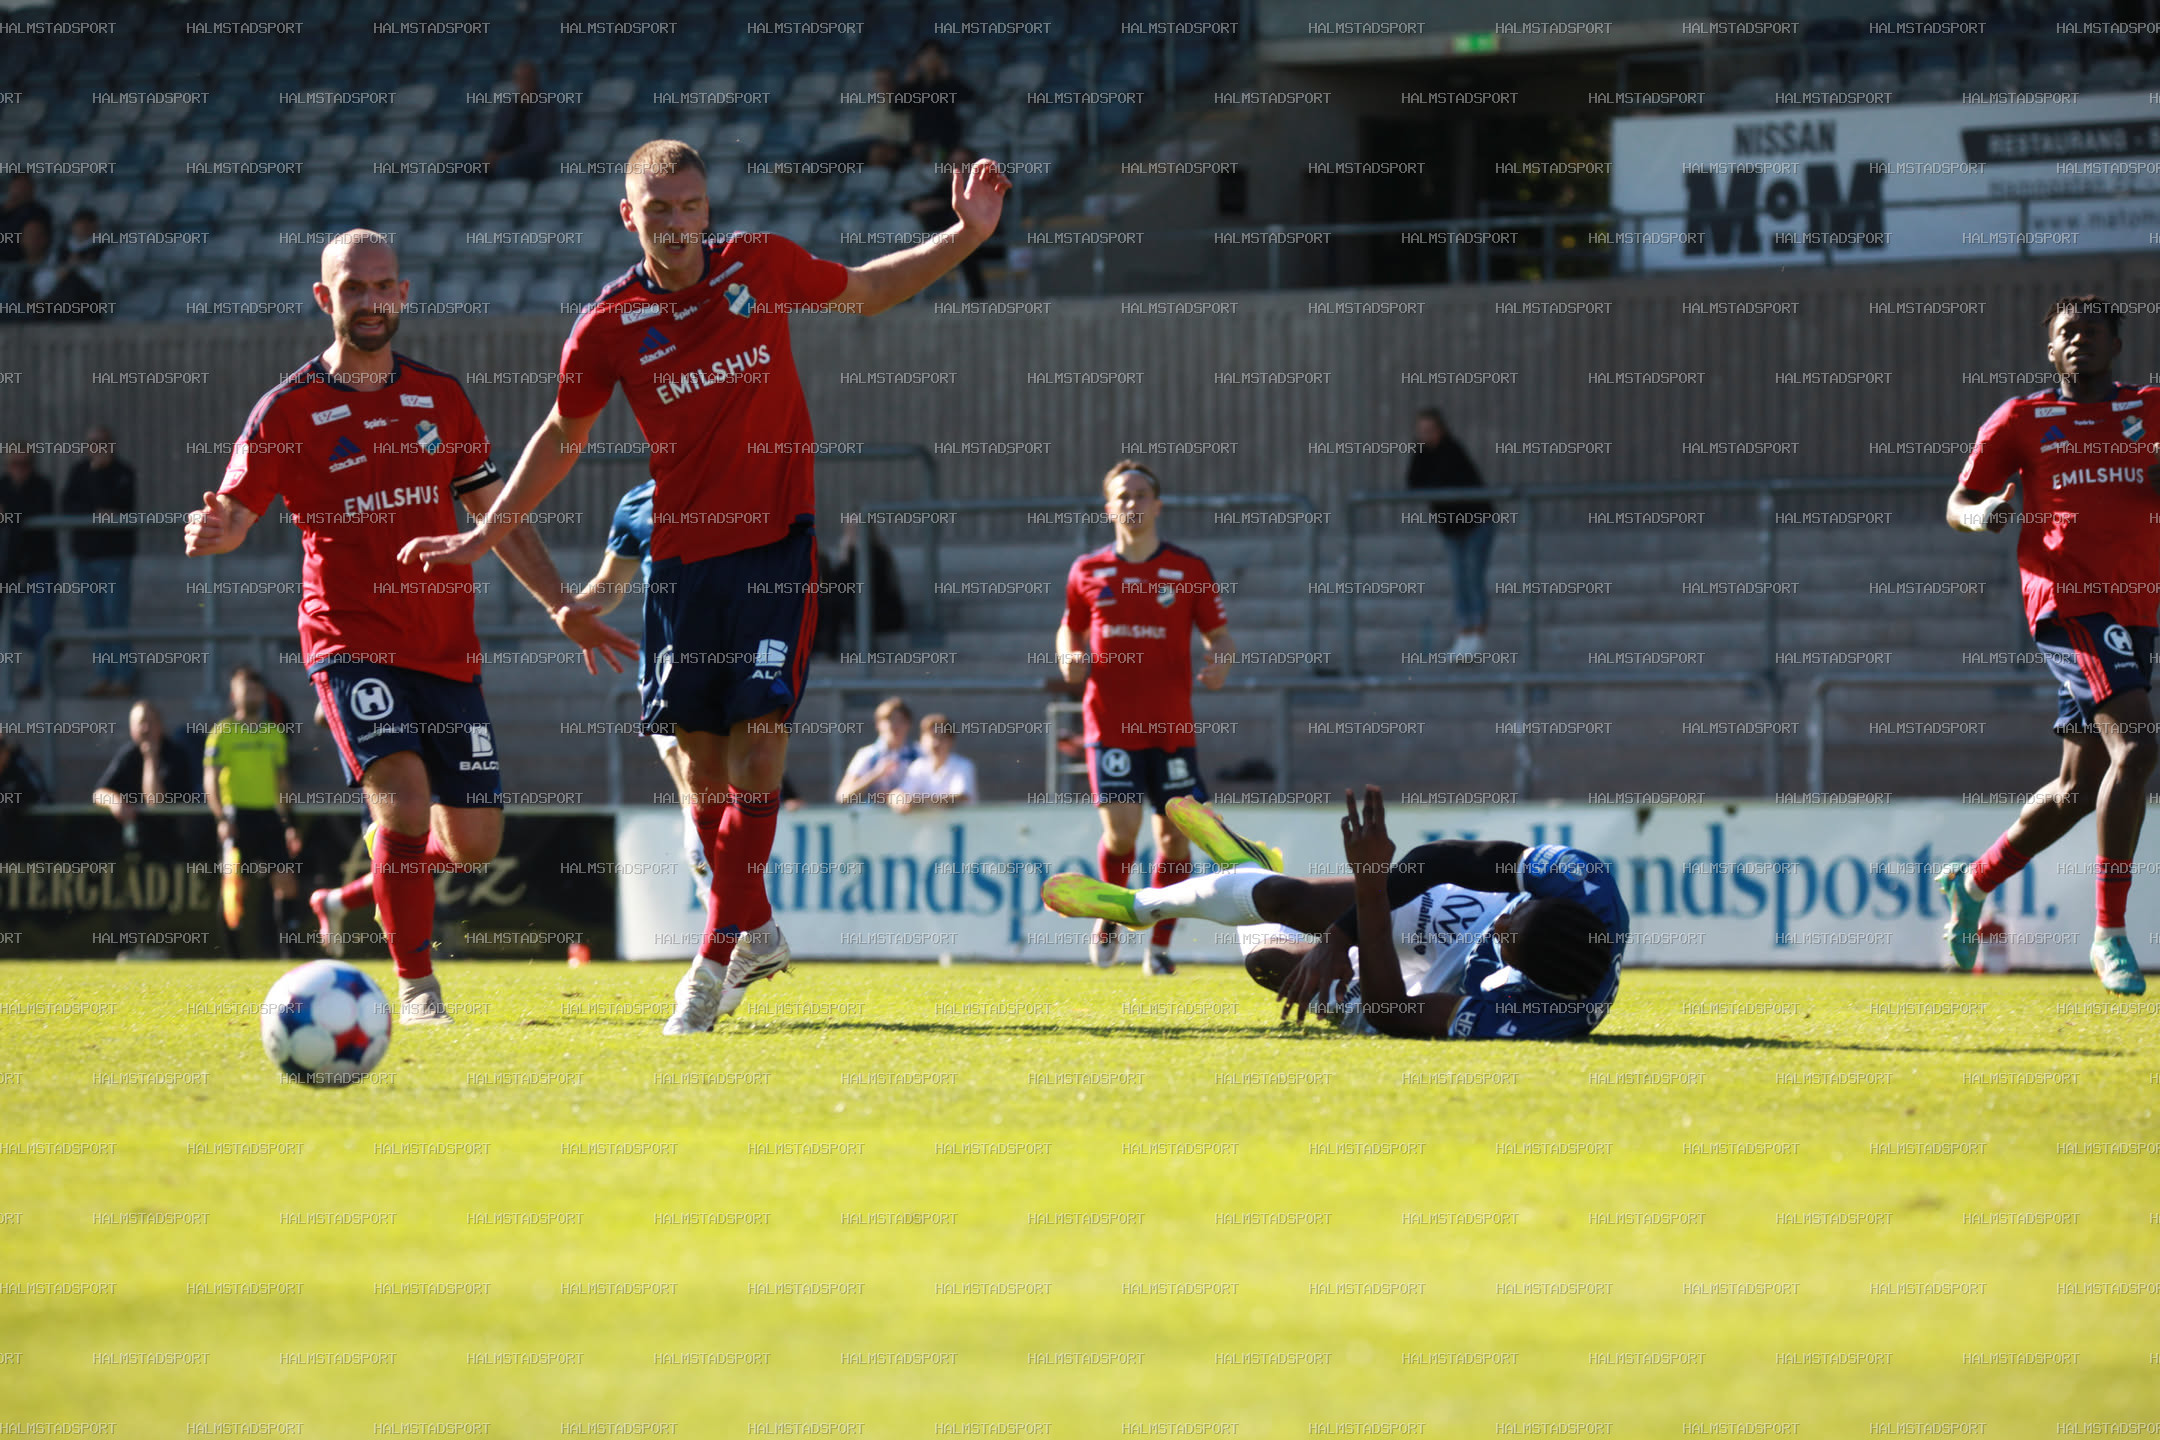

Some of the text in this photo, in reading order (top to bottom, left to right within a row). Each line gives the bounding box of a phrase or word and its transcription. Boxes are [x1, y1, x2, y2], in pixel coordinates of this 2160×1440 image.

[1735, 120, 1836, 156] NISSAN
[639, 344, 677, 366] stadium
[656, 344, 771, 405] EMILSHUS
[329, 454, 367, 473] stadium
[2052, 467, 2144, 490] EMILSHUS
[344, 485, 439, 517] EMILSHUS
[459, 760, 500, 771] BALC
